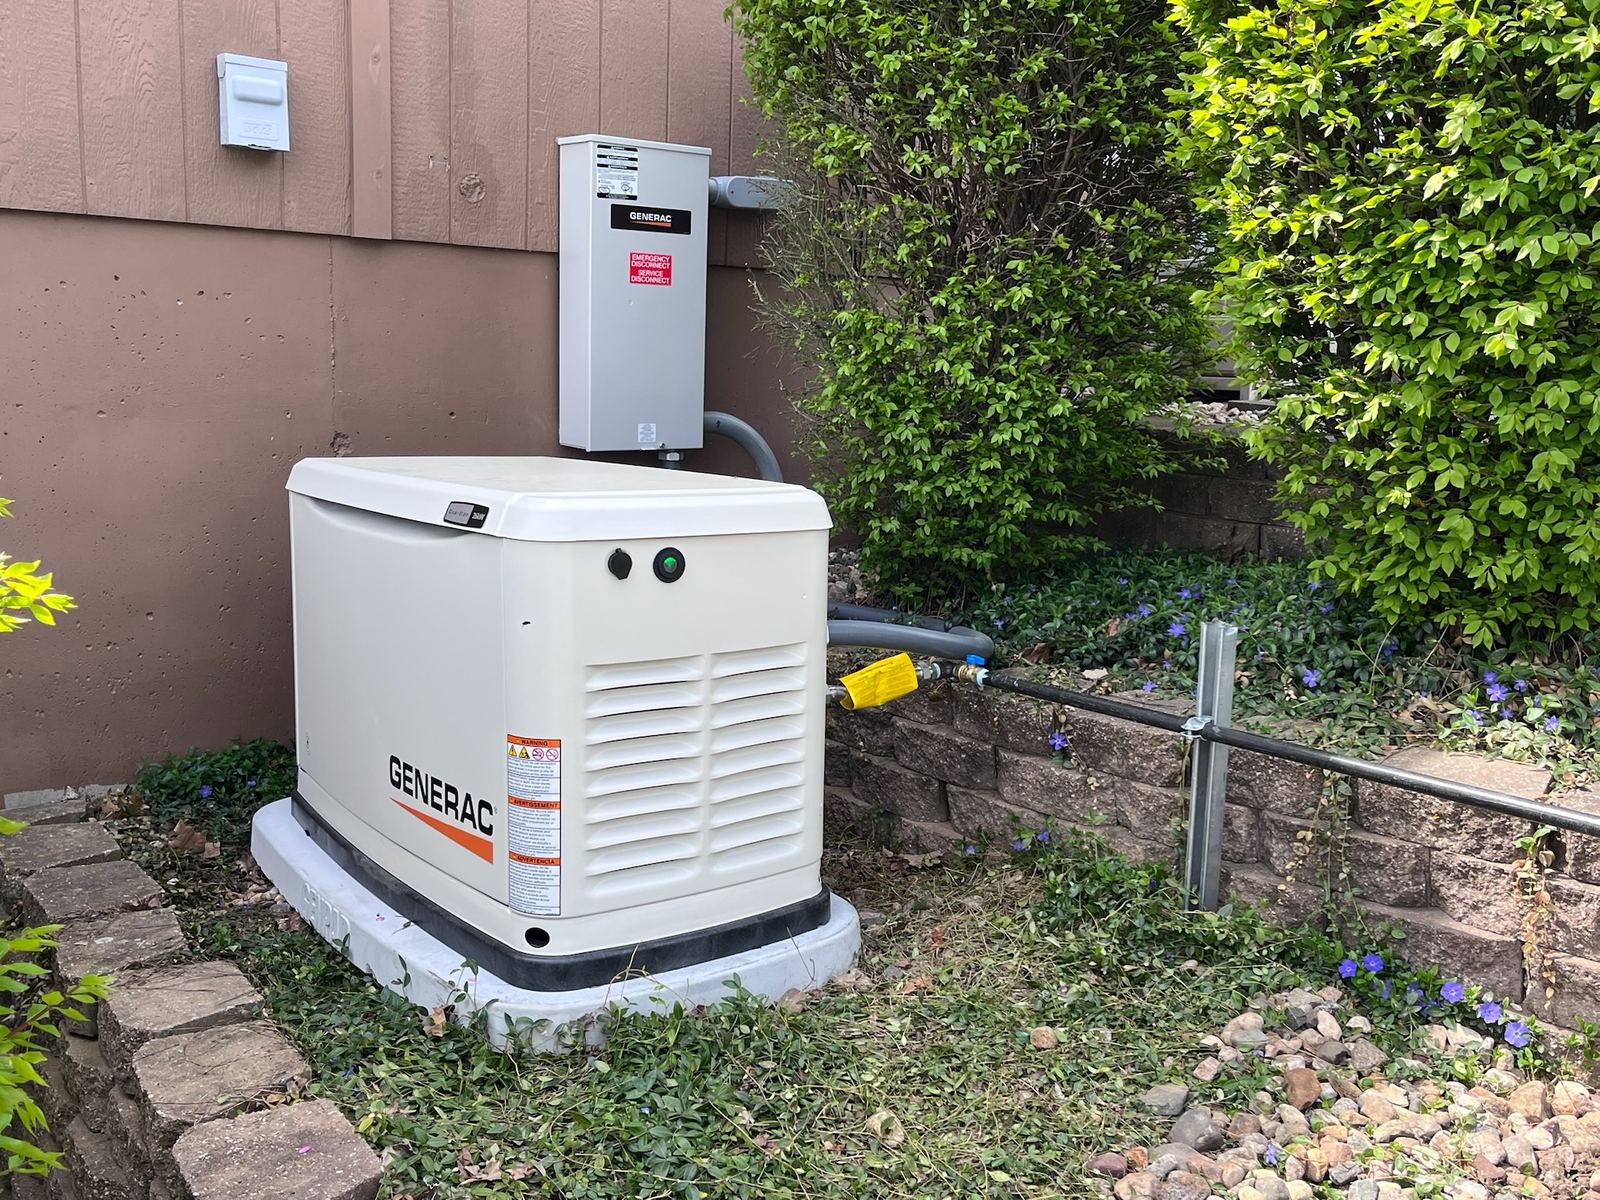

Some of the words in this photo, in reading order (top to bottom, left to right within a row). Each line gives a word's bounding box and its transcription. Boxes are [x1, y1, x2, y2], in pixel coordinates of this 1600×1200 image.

[629, 211, 672, 222] GENERAC
[632, 254, 670, 262] EMERGENCY
[631, 260, 670, 269] DISCONNECT
[638, 269, 664, 277] SERVICE
[630, 275, 670, 285] DISCONNECT
[389, 754, 494, 837] GENERAC
[512, 798, 558, 808] AVERTISSEMENT
[517, 855, 555, 865] ADVERTENCIA
